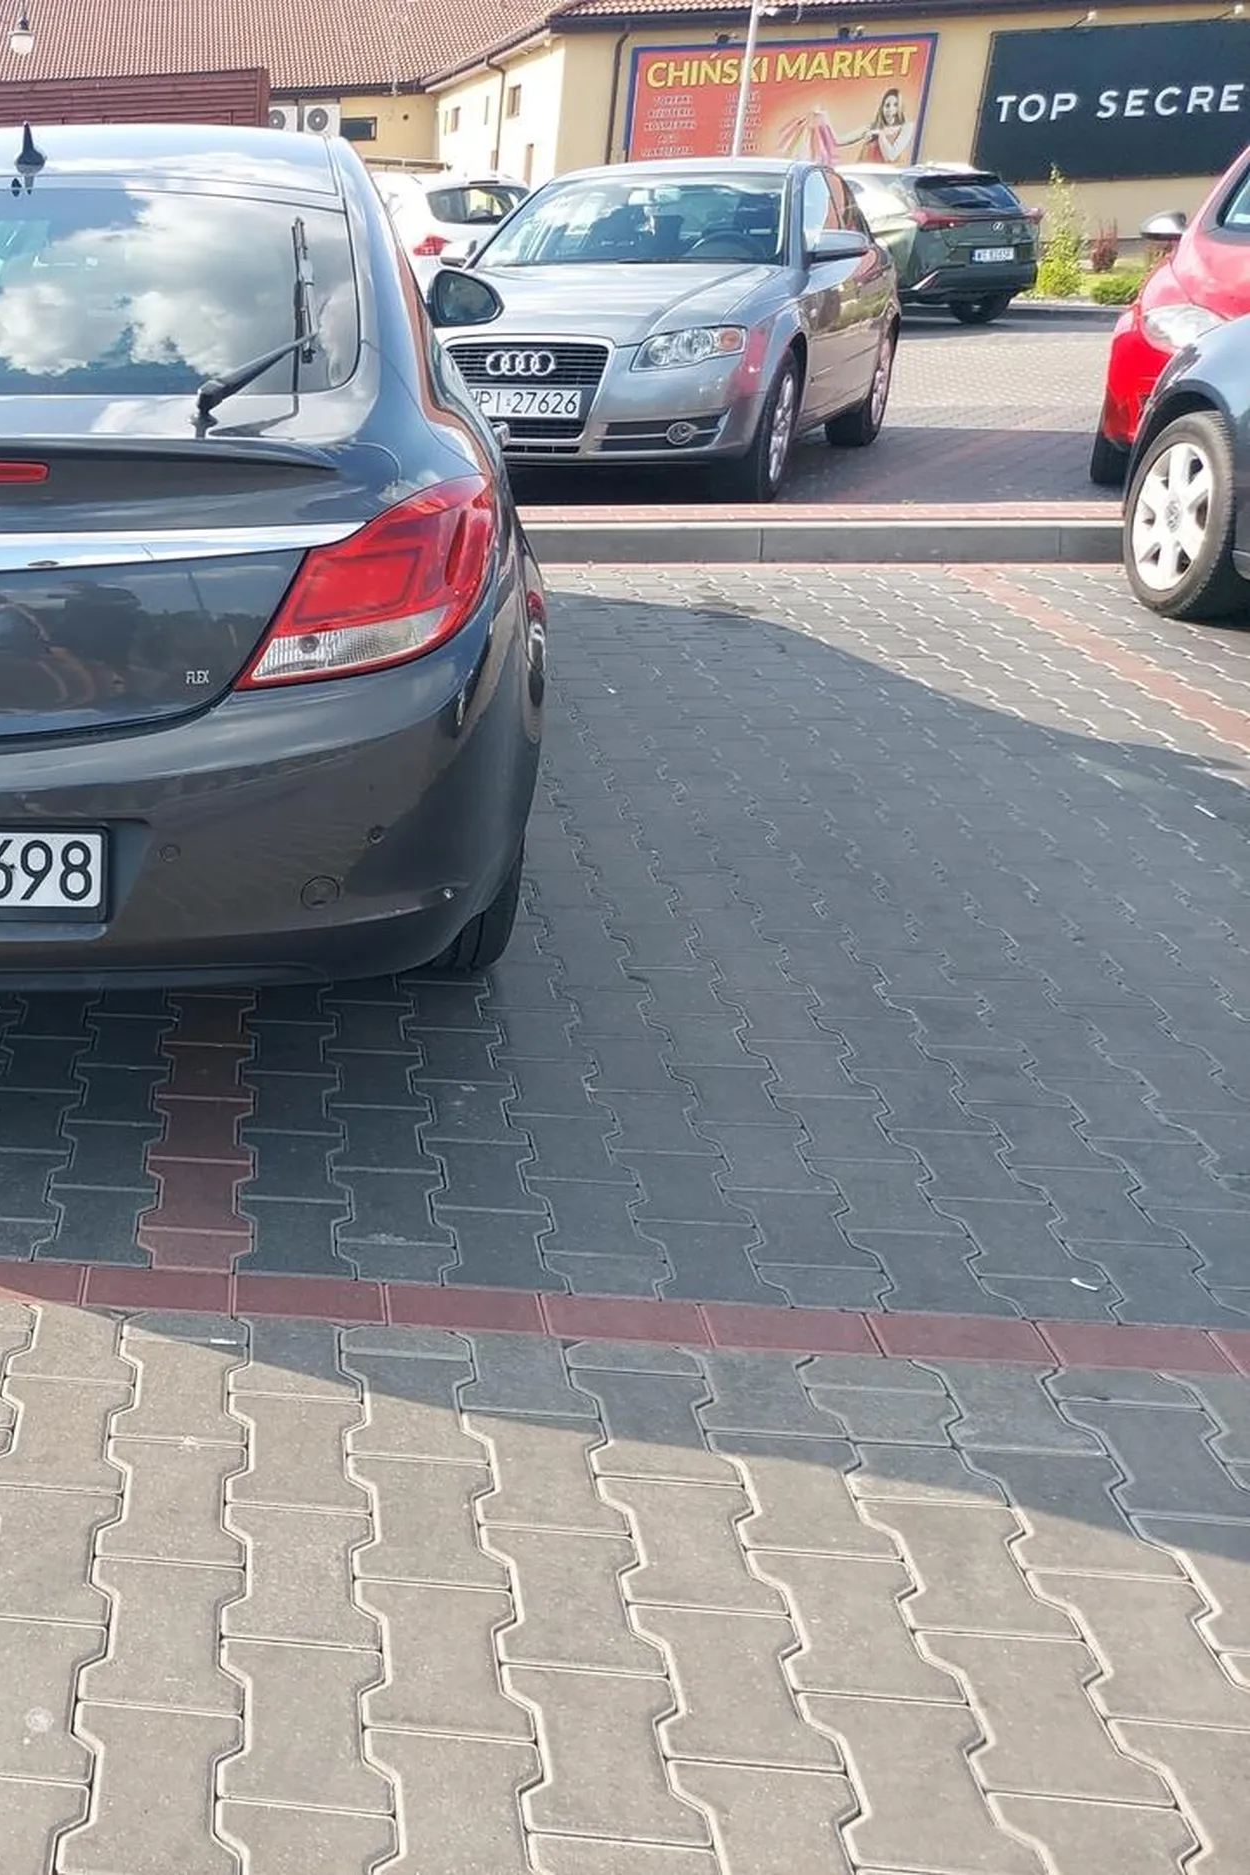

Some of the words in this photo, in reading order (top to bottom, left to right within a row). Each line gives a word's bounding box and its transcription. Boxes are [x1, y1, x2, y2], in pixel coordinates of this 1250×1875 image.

[775, 46, 918, 82] MARKET
[996, 93, 1078, 122] TOP
[1096, 84, 1245, 118] SECRE
[511, 391, 578, 414] 27626
[186, 670, 210, 684] FLEX
